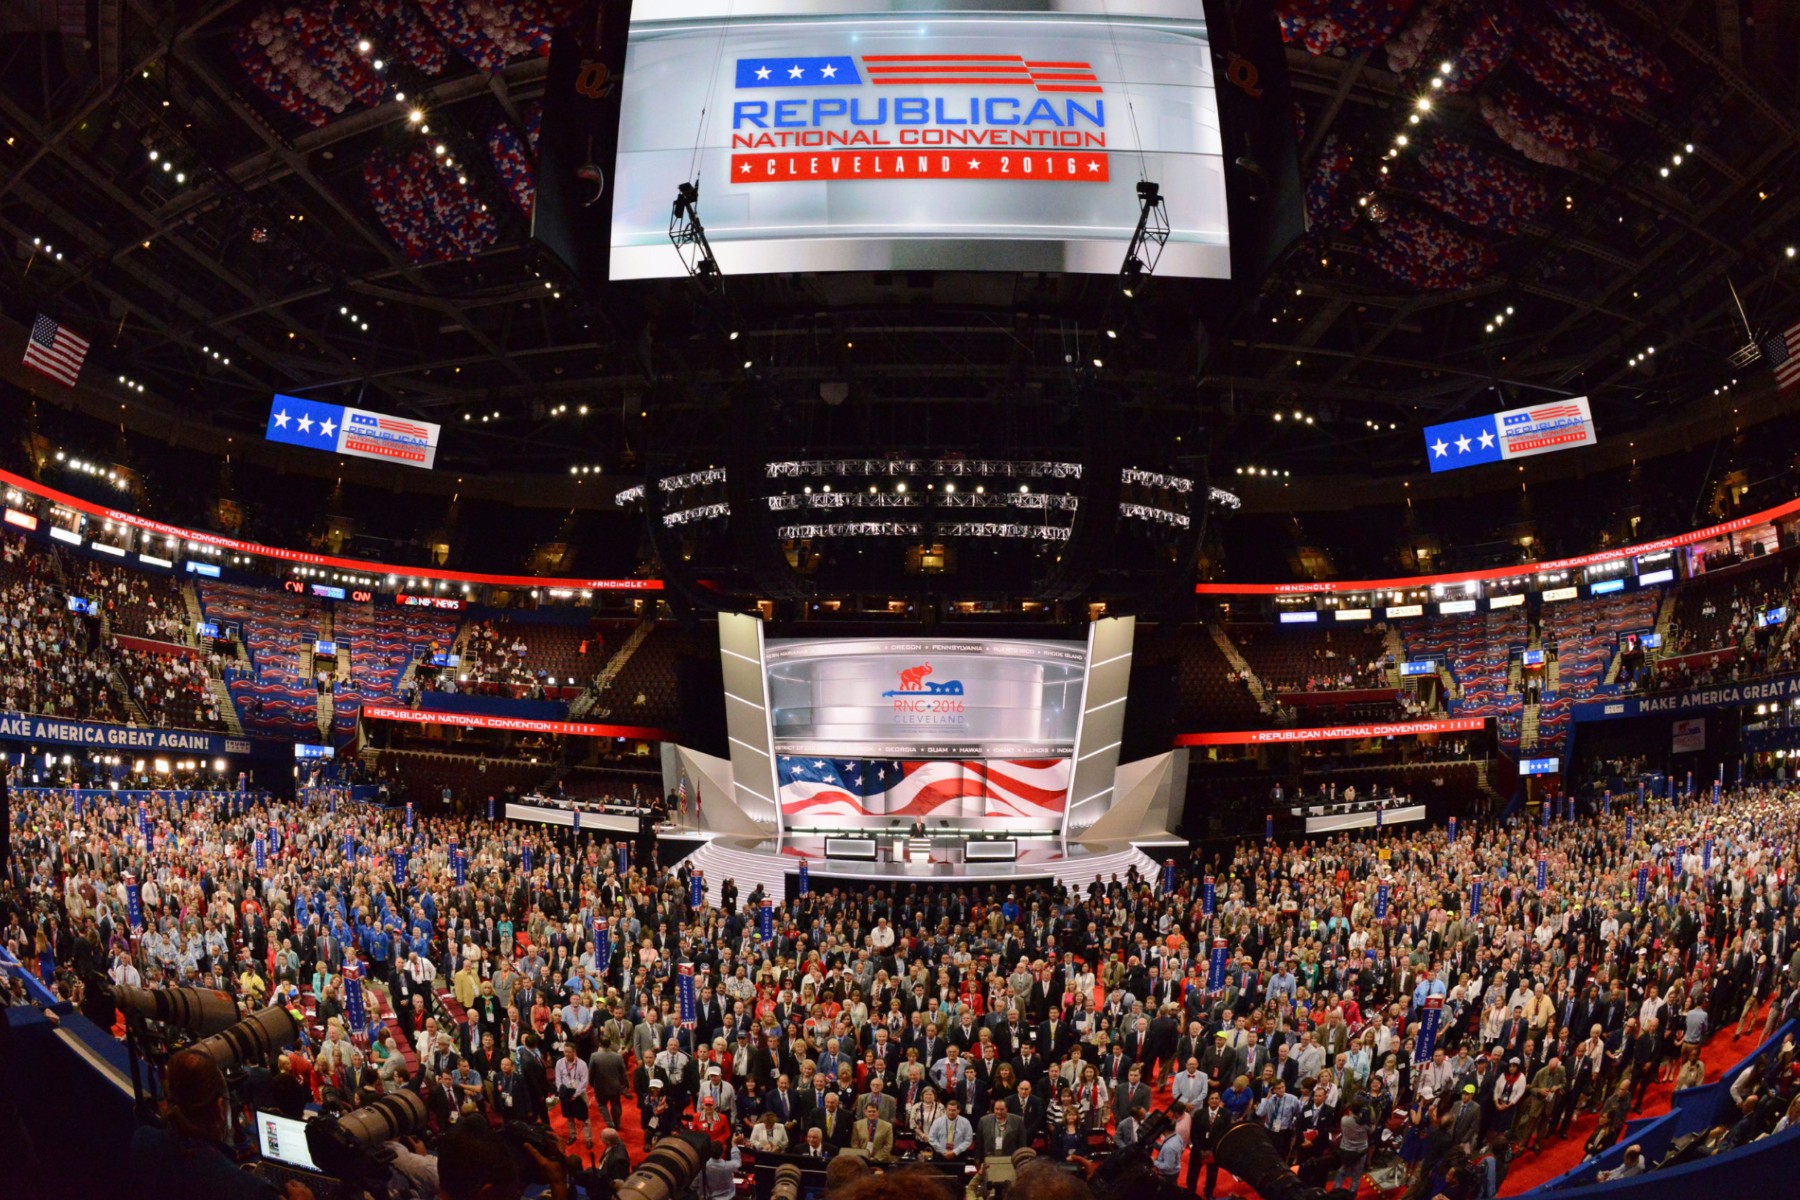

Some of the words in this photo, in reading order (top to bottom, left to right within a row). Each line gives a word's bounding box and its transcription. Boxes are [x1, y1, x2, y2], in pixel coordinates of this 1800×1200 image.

[733, 97, 1105, 129] REPUBLICAN
[732, 129, 890, 149] NATIONAL
[899, 128, 1106, 147] CONVENTION
[767, 156, 950, 175] CLEVELAND
[1000, 156, 1076, 174] 2016
[348, 426, 428, 447] REPUBLICAN
[1505, 416, 1584, 437] REPUBLICAN
[109, 511, 155, 528] REPUBLICAN
[155, 523, 190, 538] NATIONAL
[191, 532, 239, 548] CONVENTION
[1540, 556, 1588, 570] REPUBLICAN
[1588, 549, 1625, 562] NATIONAL
[1625, 539, 1673, 556] CONVENTION
[352, 591, 371, 602] CNN
[436, 600, 459, 610] NEWS
[893, 699, 926, 713] RNC
[932, 699, 965, 713] 2016
[1639, 696, 1676, 712] MAKE
[1681, 688, 1739, 708] AMERICA
[1743, 681, 1785, 700] GREAT
[373, 709, 435, 721] REPUBLICAN
[438, 715, 485, 726] NATIONAL
[488, 719, 551, 730] CONVENTION
[893, 715, 964, 724] CLEVELAND
[35, 722, 102, 744] AMERICA
[107, 729, 155, 747] GREAT
[158, 733, 209, 750] AGAIN!
[1259, 730, 1321, 741] REPUBLICAN
[1323, 726, 1371, 738] NATIONAL
[1373, 723, 1437, 735] CONVENTION
[131, 891, 139, 915] GUAM
[348, 980, 358, 1027] VIRGINIA
